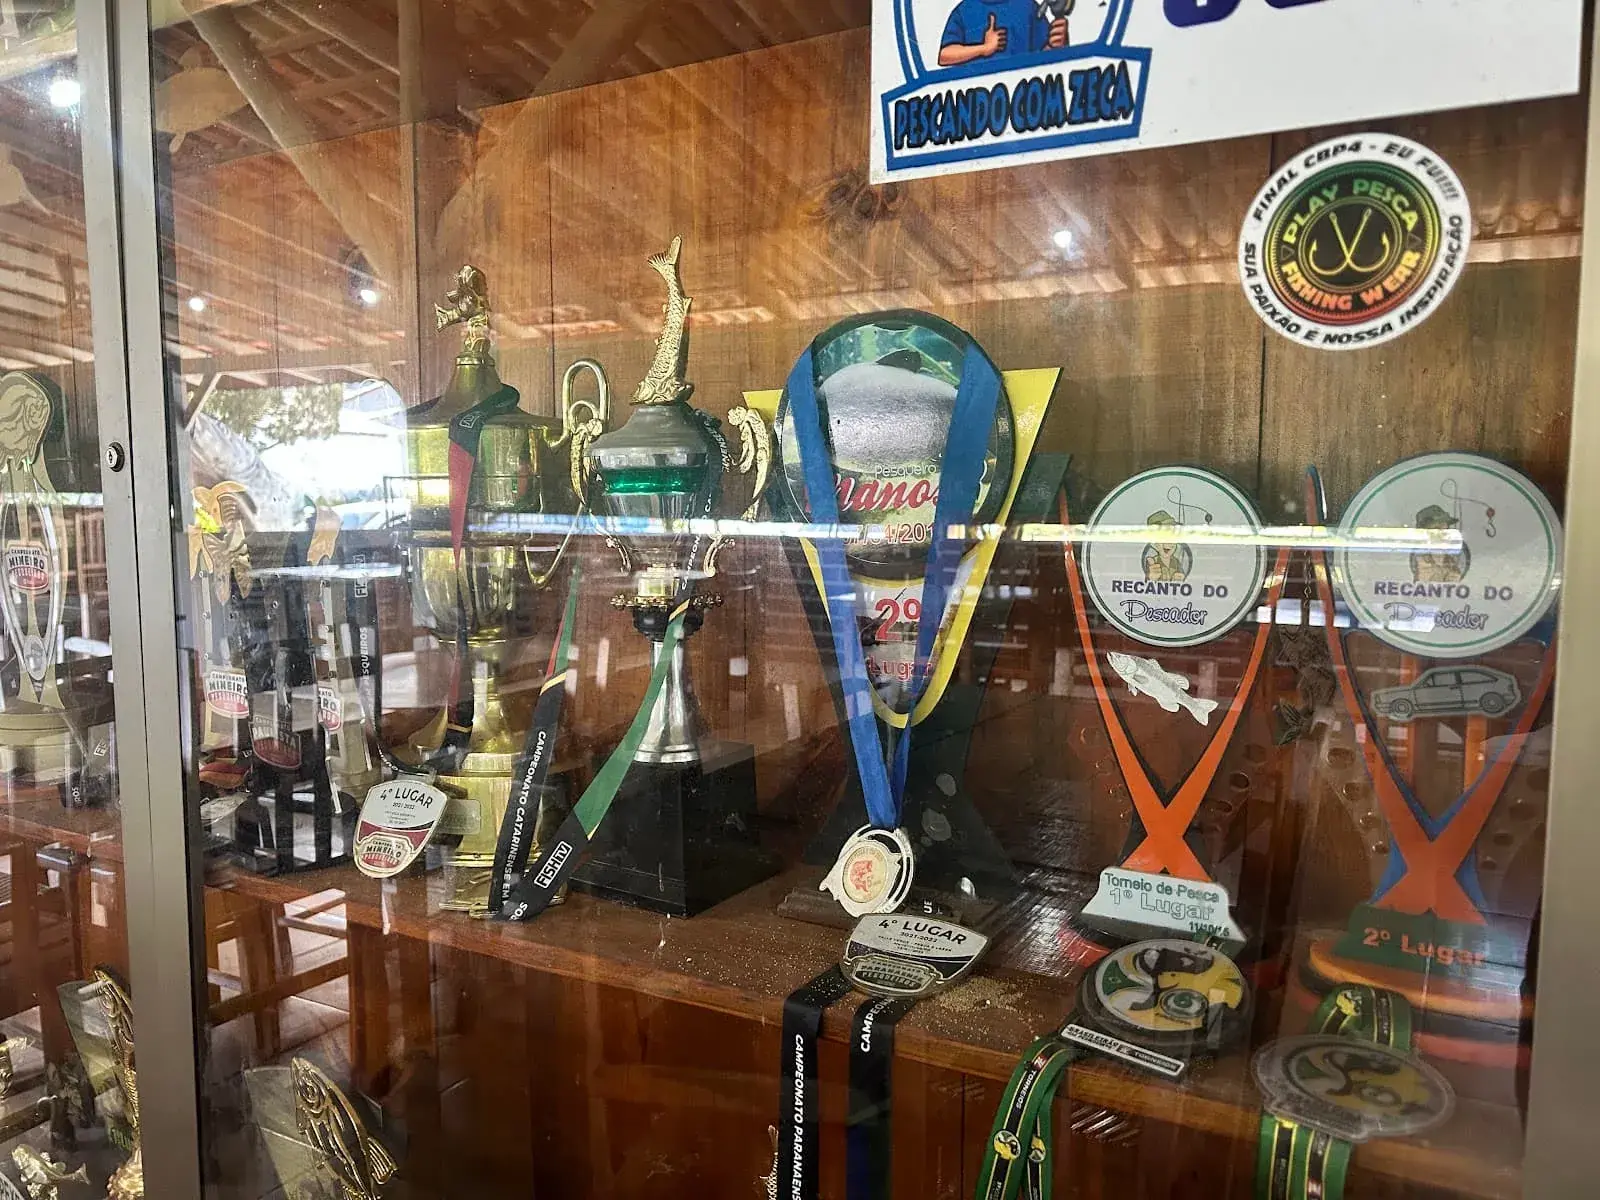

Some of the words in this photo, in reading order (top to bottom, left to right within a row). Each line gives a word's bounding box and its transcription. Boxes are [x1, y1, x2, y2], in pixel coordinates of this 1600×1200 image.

[894, 82, 1009, 150] PESCANDO
[1009, 73, 1068, 134] COM
[1067, 59, 1136, 125] ZECA
[1253, 169, 1299, 222] FINAL
[1303, 140, 1363, 169] CBP4
[1383, 142, 1415, 160] EU
[1283, 183, 1340, 244] PLAY
[1352, 178, 1420, 232] PESCA
[1243, 241, 1258, 280] SUA
[1322, 321, 1394, 344] NOSSA
[1280, 260, 1353, 311] FISHING
[1360, 249, 1422, 306] WEAR
[9, 555, 45, 570] MINEIRO
[1111, 580, 1193, 597] RECANTO
[1203, 584, 1228, 598] DO
[1373, 581, 1471, 599] RECANTO
[1483, 585, 1514, 601] DO
[1119, 599, 1208, 626] Pescador
[519, 730, 547, 805] CAMPEONATO
[394, 787, 434, 809] LUGAR
[504, 806, 526, 882] CATARINENSE
[1140, 892, 1215, 920] Lugar
[1156, 882, 1173, 896] de
[1176, 884, 1220, 904] Pesca
[902, 920, 968, 946] LUGAR
[1400, 933, 1486, 966] Lugar
[793, 1034, 805, 1124] CAMPEONATO
[1015, 1070, 1037, 1110] TORNEIOS
